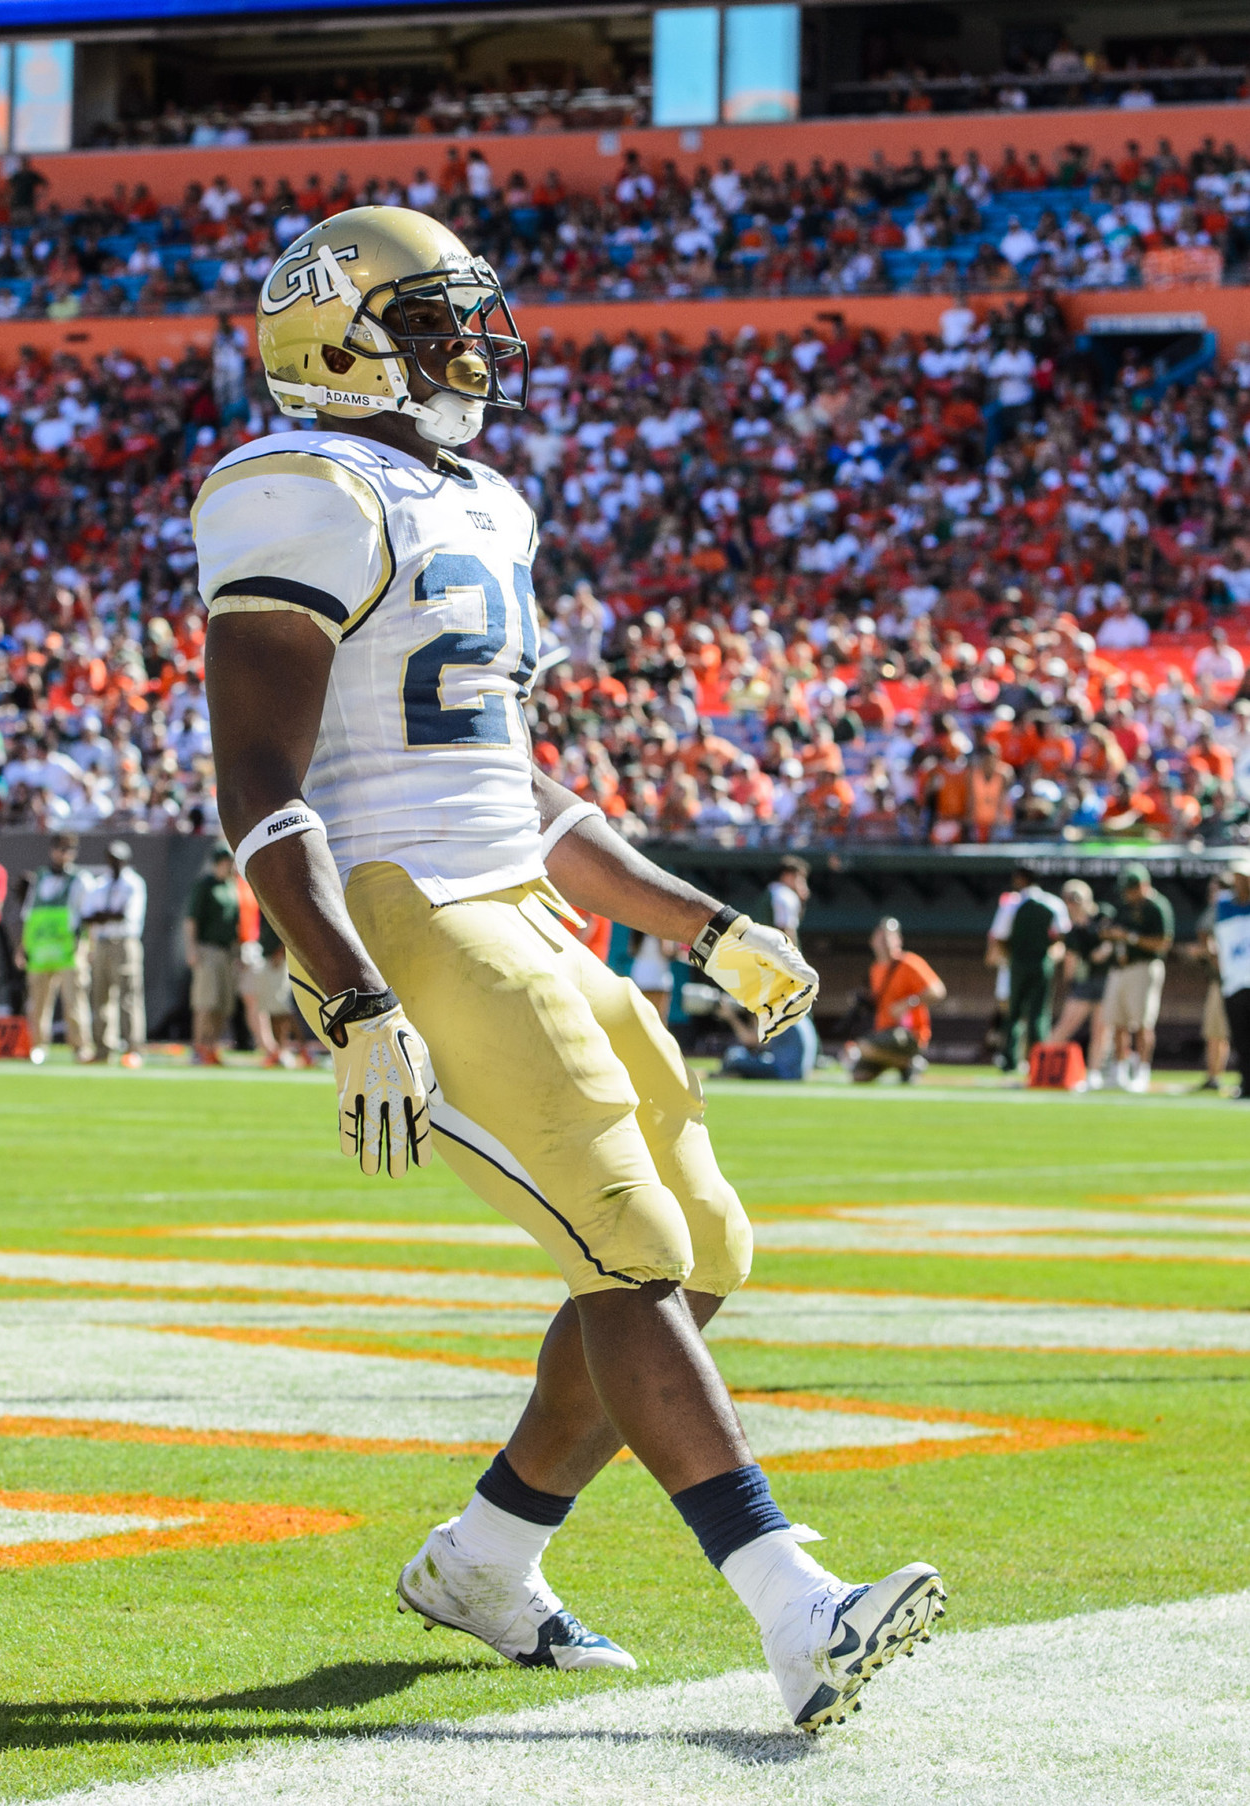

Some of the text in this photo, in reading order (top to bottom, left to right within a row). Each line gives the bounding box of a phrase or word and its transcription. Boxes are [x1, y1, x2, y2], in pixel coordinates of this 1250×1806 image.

[261, 242, 359, 316] GT
[325, 391, 371, 406] ADAMS
[465, 509, 498, 532] TECH
[267, 814, 310, 836] RUSSELL
